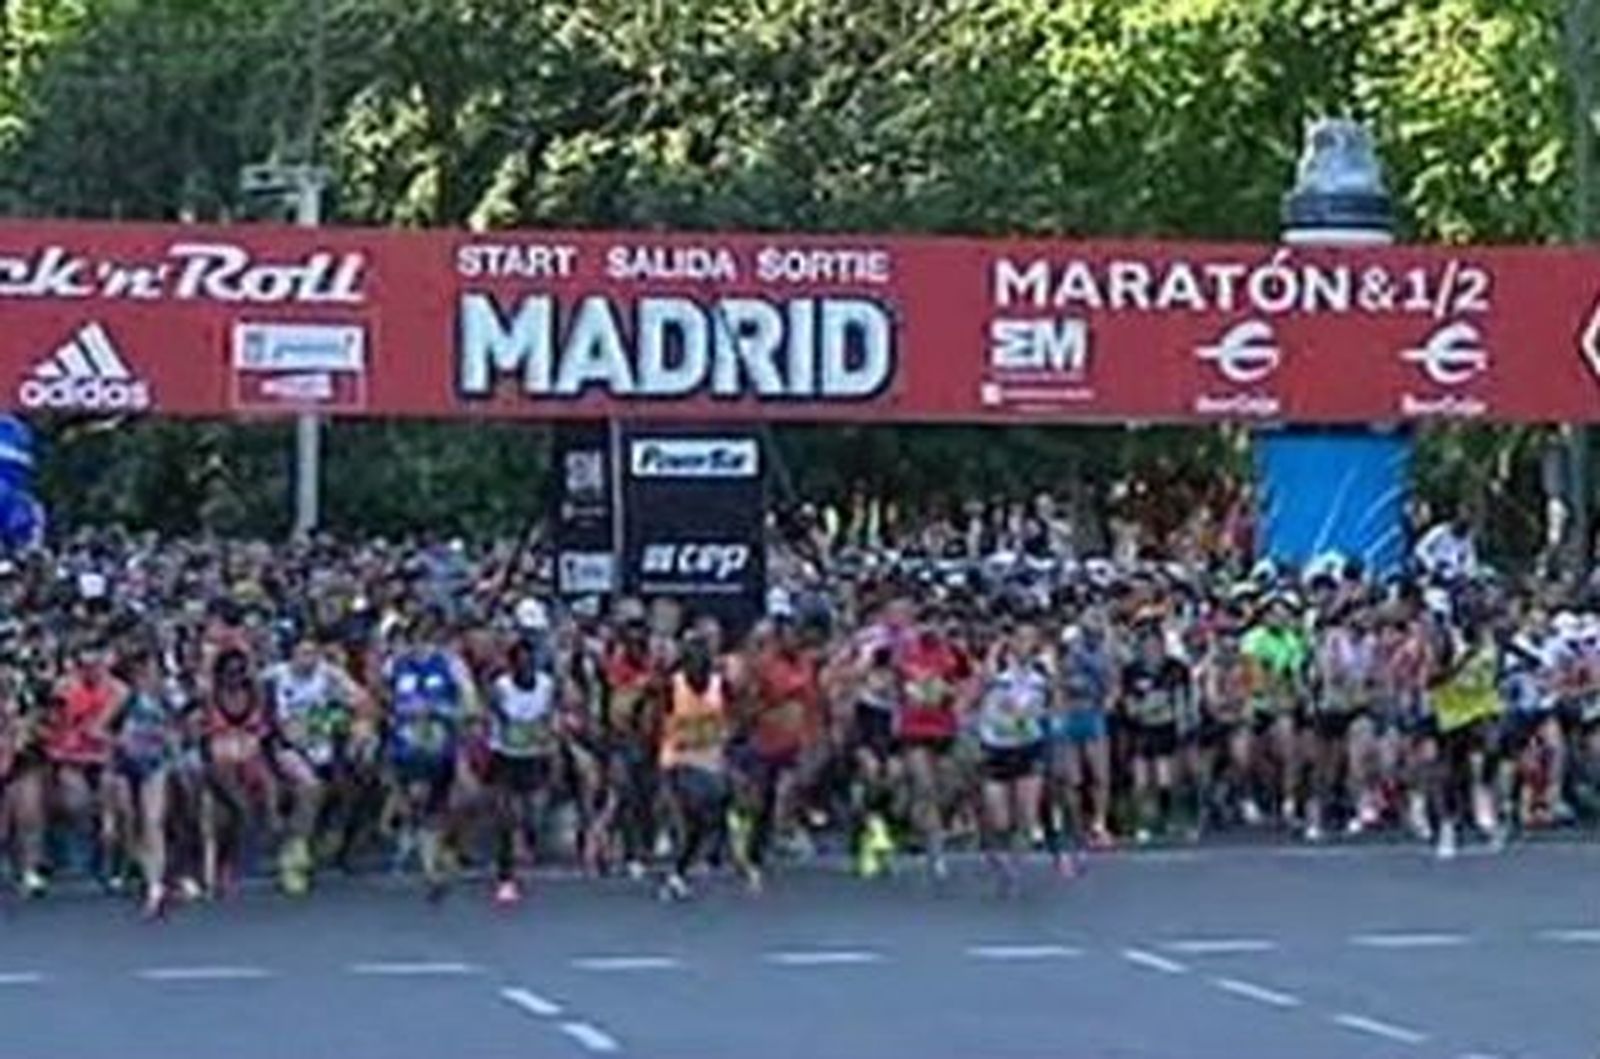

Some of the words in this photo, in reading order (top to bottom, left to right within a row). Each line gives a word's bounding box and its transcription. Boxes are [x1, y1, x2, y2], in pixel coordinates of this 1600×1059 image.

[457, 246, 577, 276] START
[607, 248, 736, 281] SALIDA
[757, 248, 889, 282] SORTIE
[459, 293, 892, 396] MADRID
